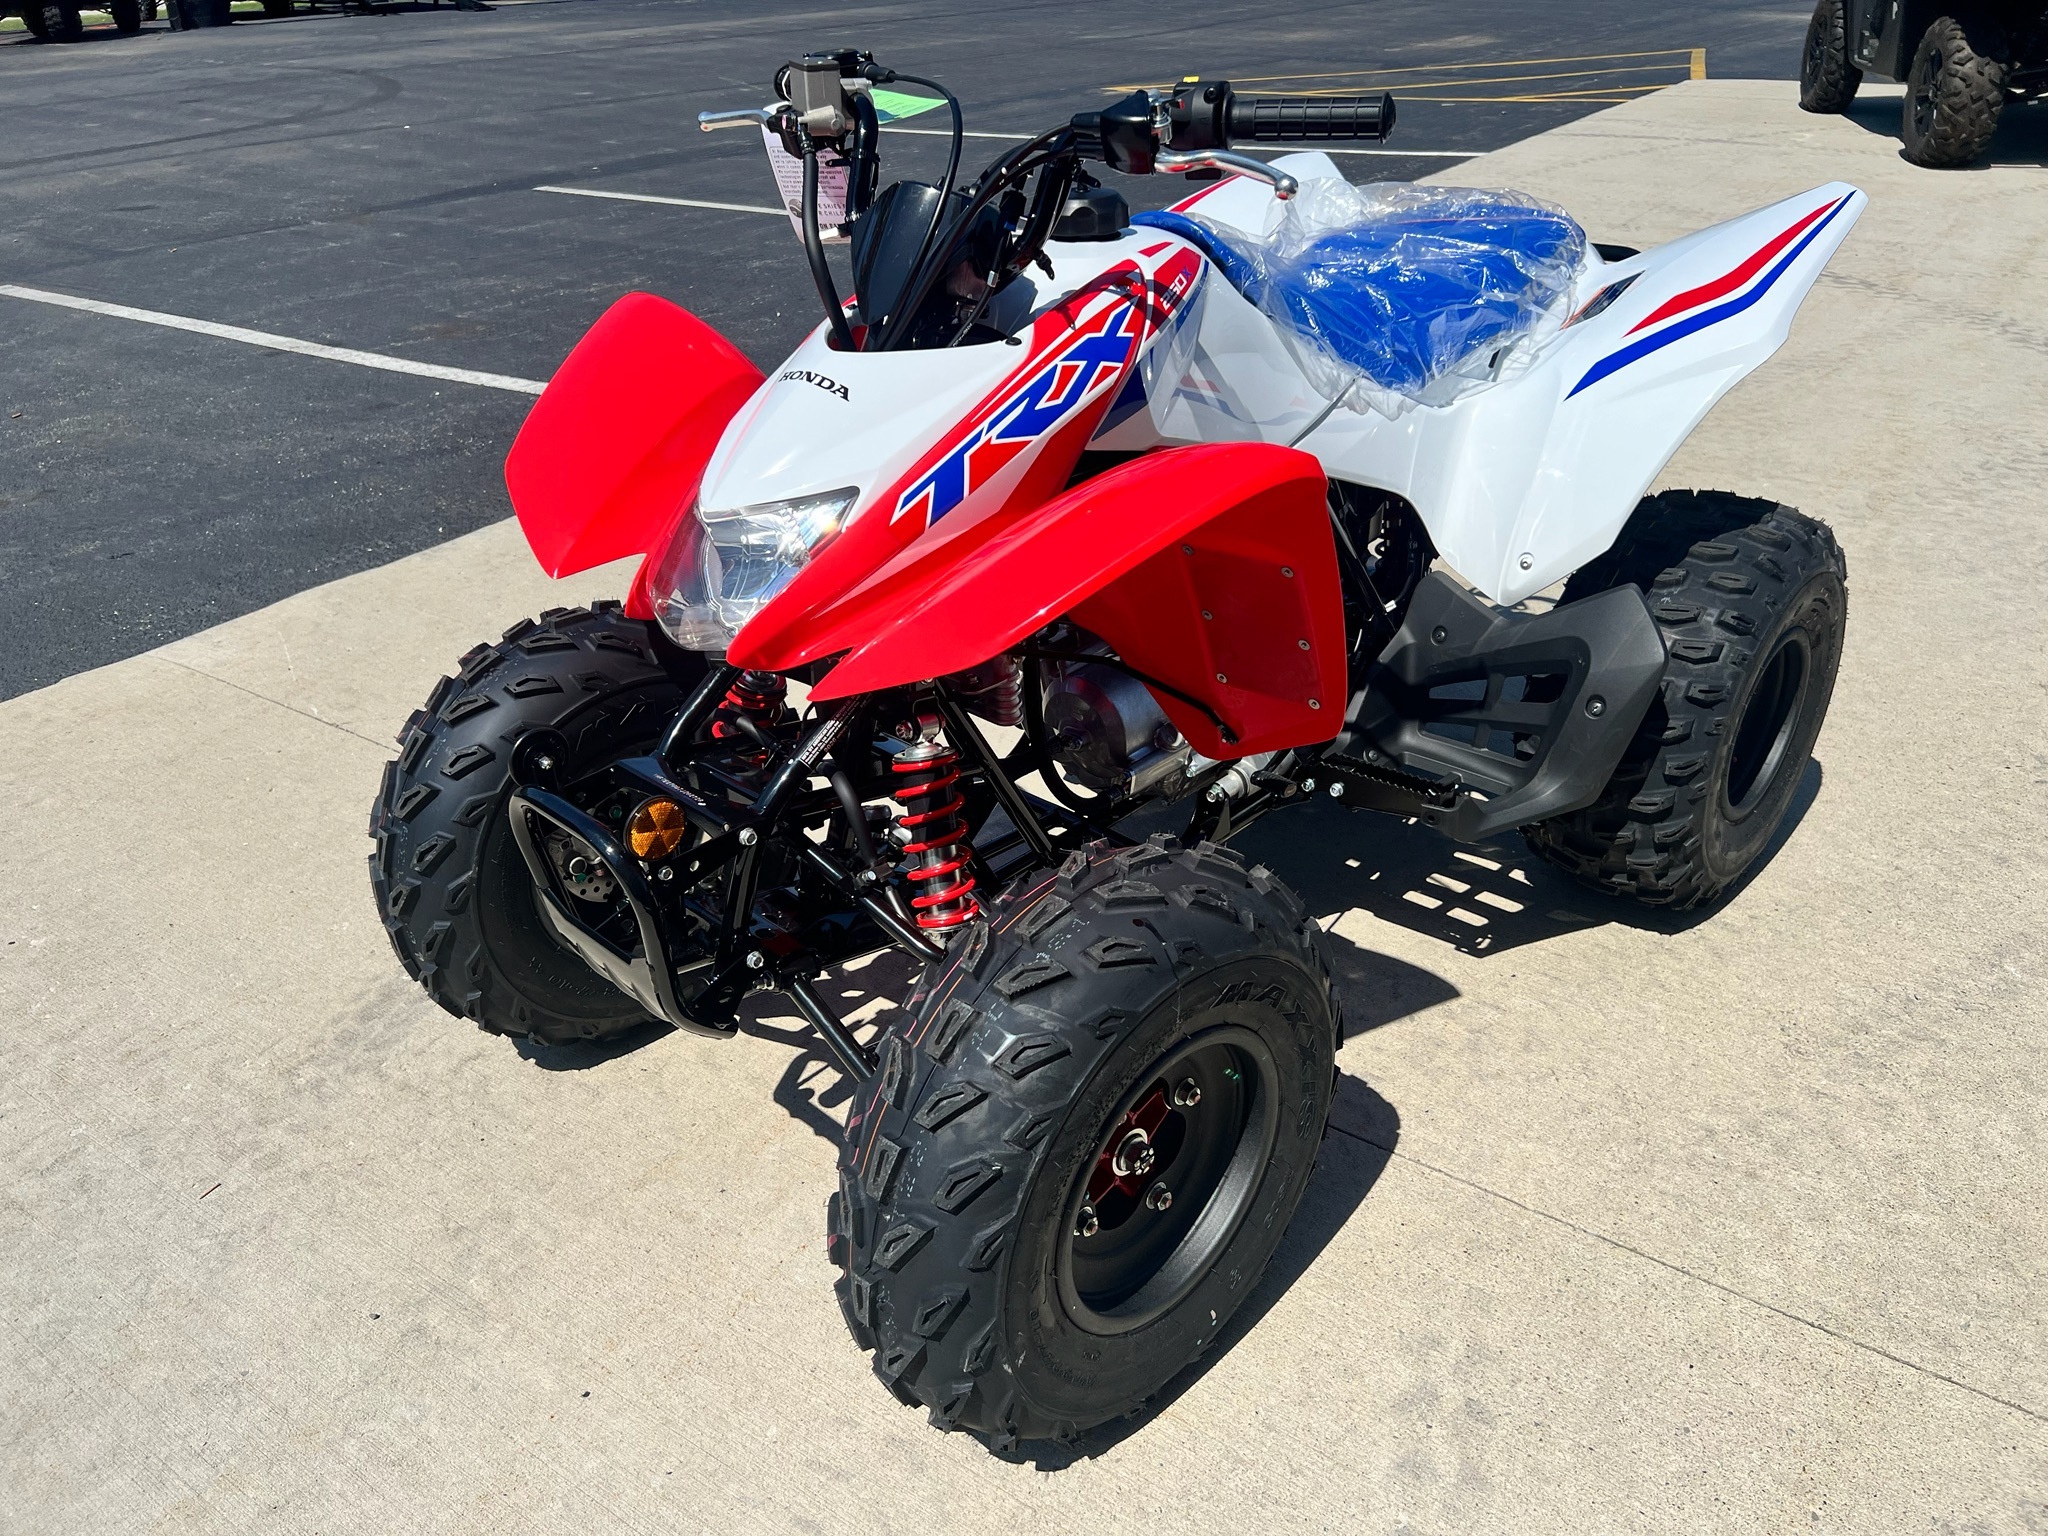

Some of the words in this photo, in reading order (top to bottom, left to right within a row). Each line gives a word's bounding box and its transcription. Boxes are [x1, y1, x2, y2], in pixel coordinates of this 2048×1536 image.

[778, 370, 850, 402] HONDA
[890, 297, 1135, 530] TRX
[1160, 266, 1192, 311] 250X
[1207, 980, 1318, 1140] MAXXIS
